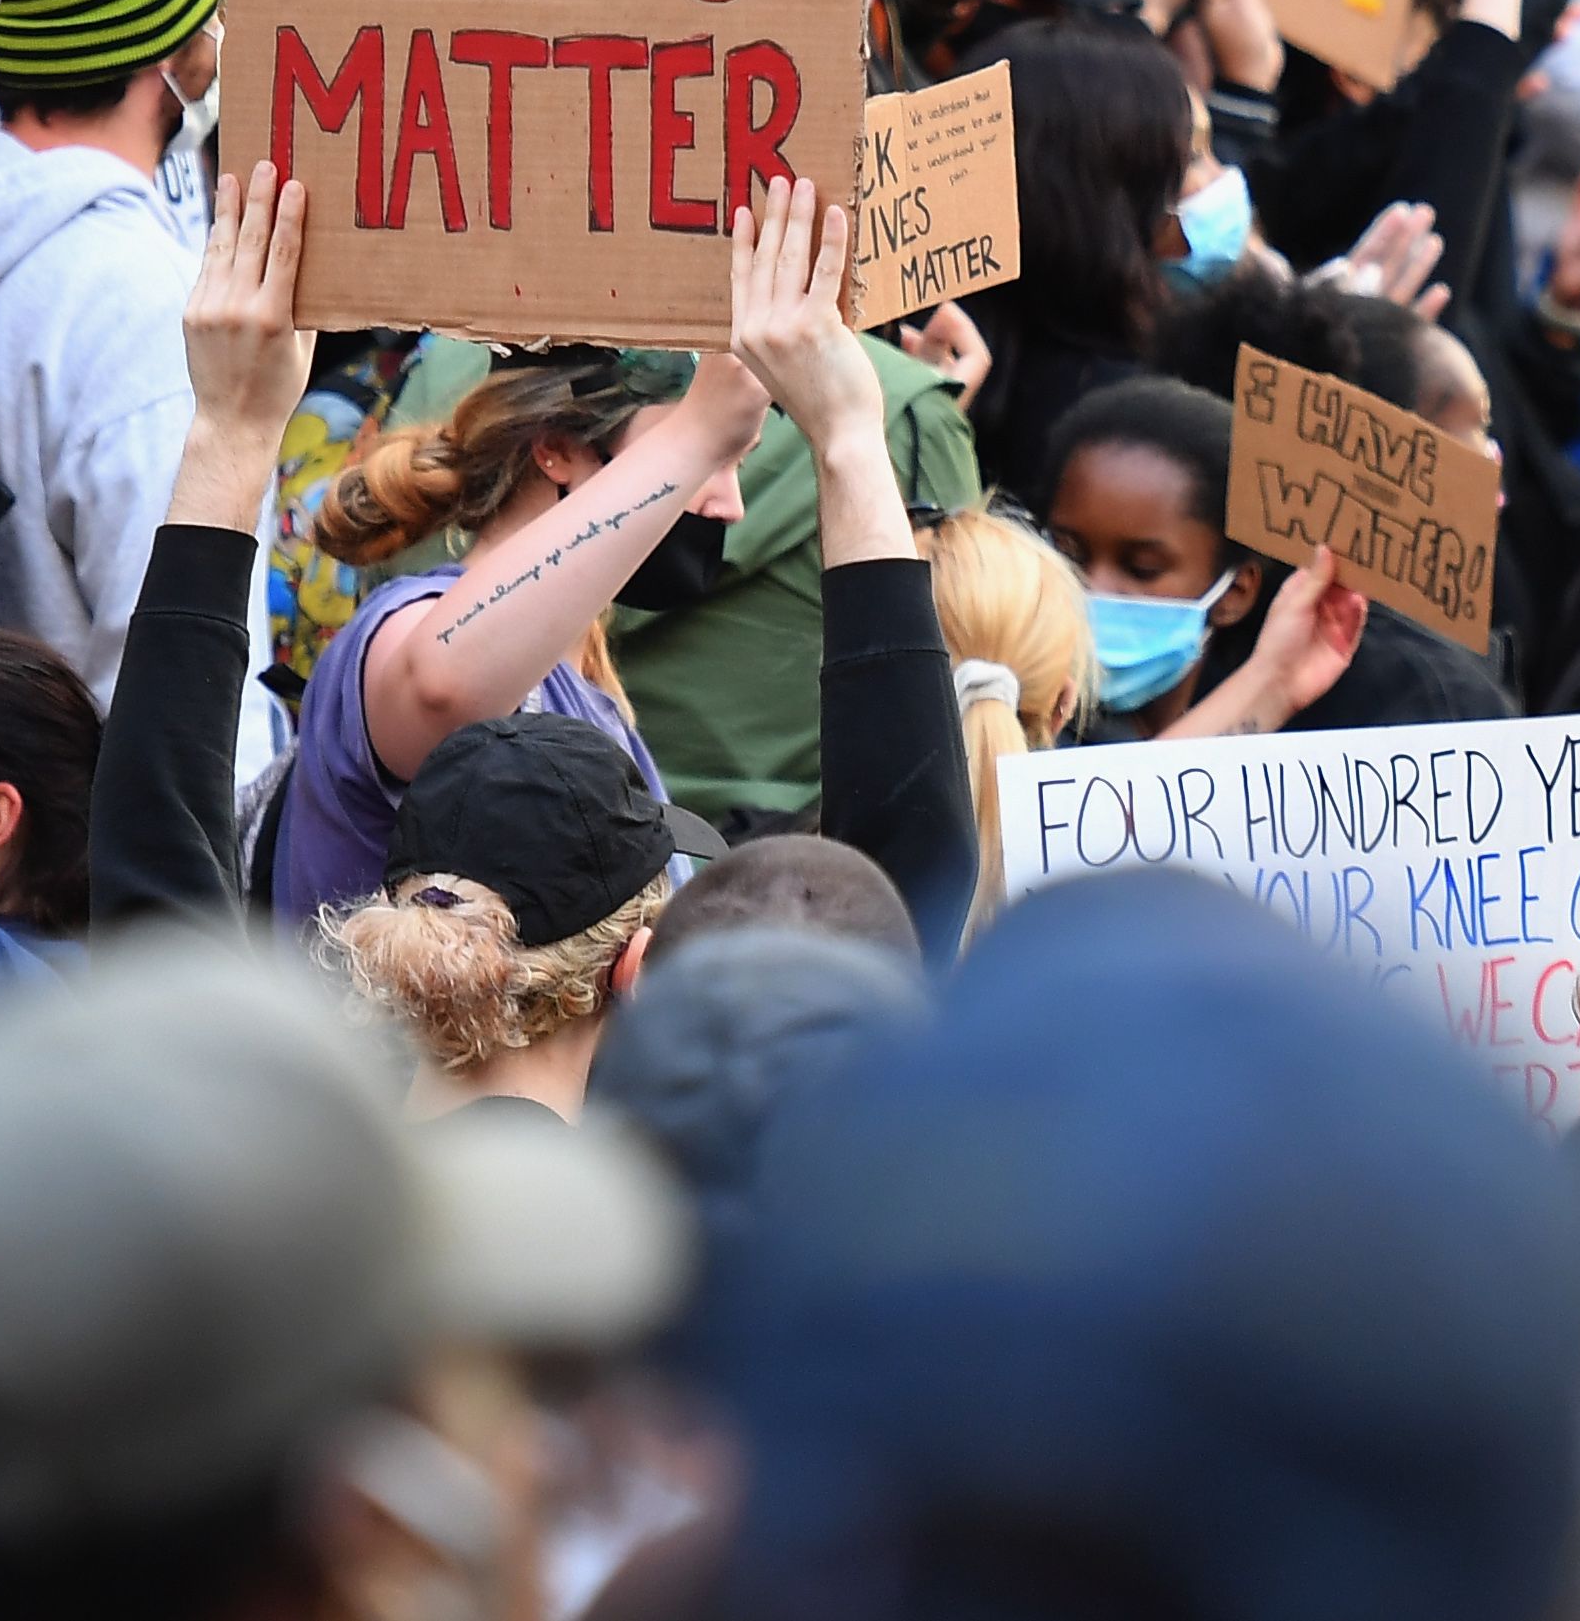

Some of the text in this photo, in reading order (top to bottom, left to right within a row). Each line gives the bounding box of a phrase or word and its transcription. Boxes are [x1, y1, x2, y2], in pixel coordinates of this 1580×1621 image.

[270, 25, 802, 235] MATTER
[900, 235, 1001, 309] MATTER
[1298, 379, 1437, 507] HAVE
[1257, 461, 1486, 621] WATER!
[1037, 768, 1224, 874] FOUR
[1241, 750, 1503, 862] HUNDRED
[1406, 846, 1554, 952] KNEE
[1436, 956, 1524, 1048] WE
